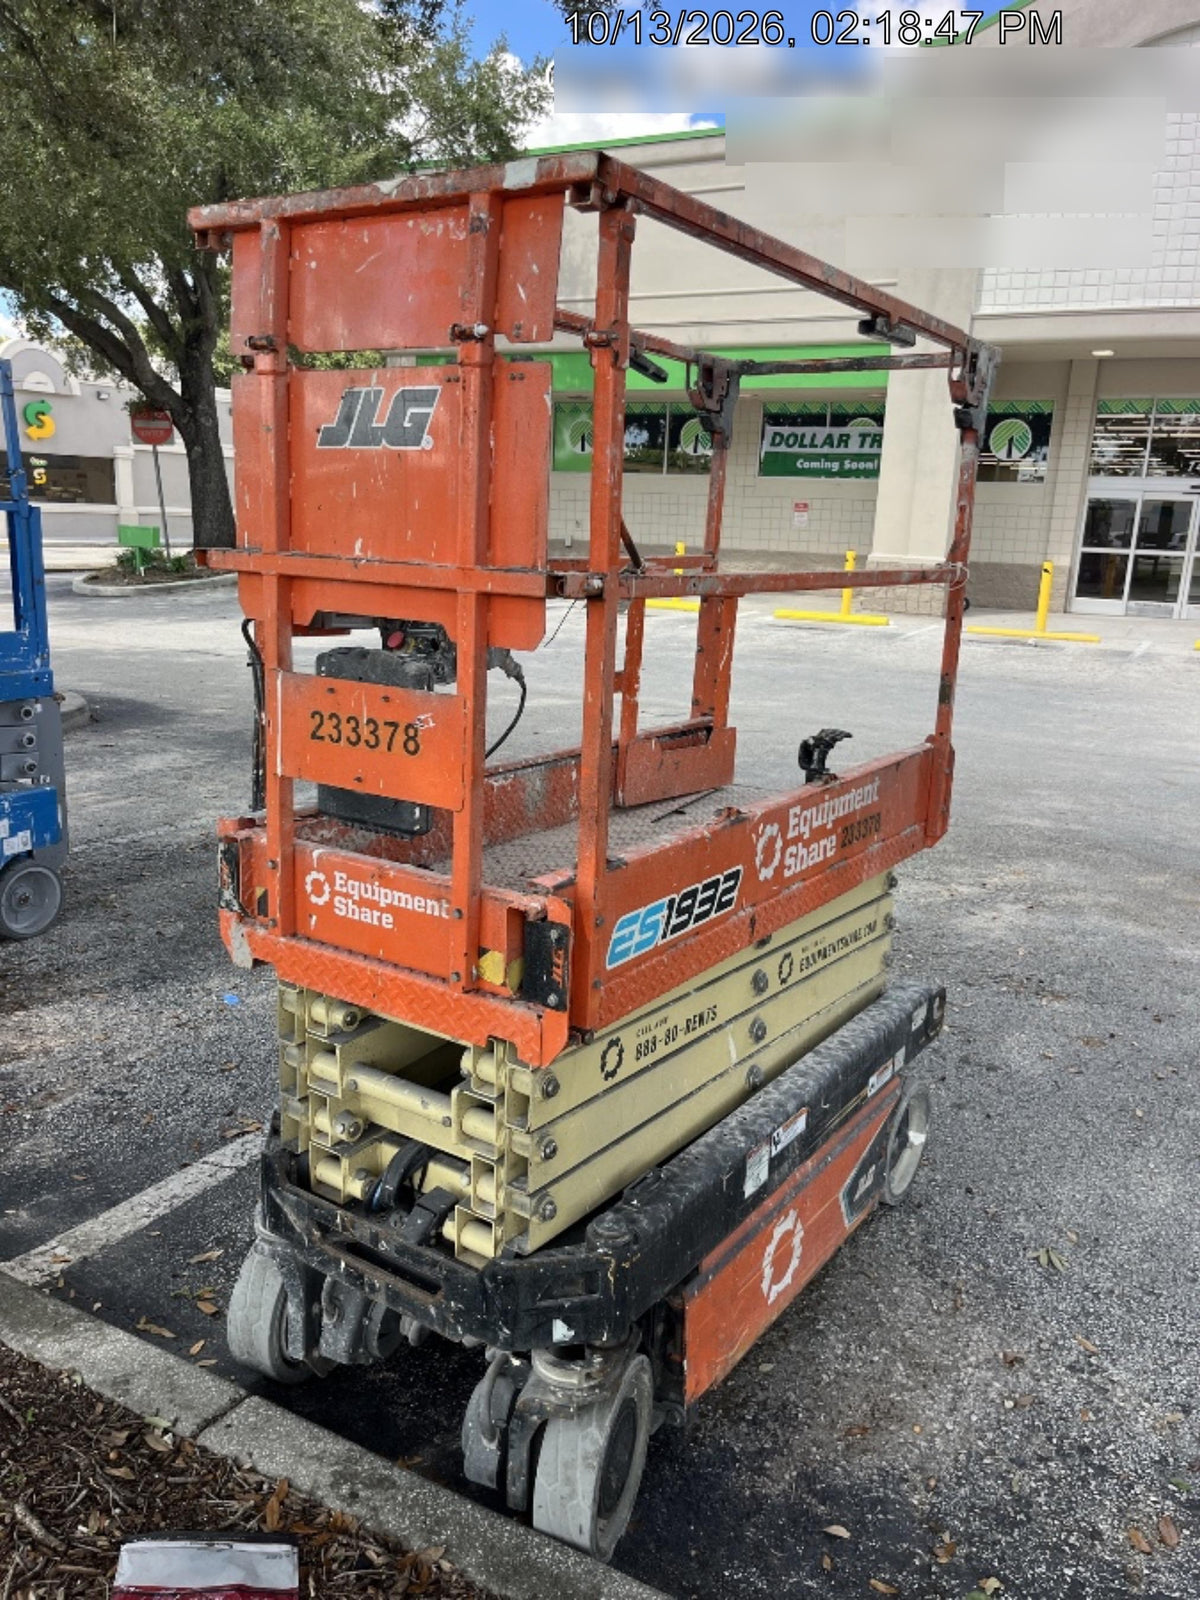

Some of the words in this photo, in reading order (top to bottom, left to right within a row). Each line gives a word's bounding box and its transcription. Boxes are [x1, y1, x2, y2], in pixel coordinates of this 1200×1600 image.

[316, 386, 442, 449] JLG
[769, 431, 851, 449] DOLLAR
[796, 458, 840, 472] Coming
[844, 458, 878, 470] Soon!
[309, 710, 421, 757] 233378
[787, 777, 880, 840] Equipment
[783, 834, 837, 878] Share
[333, 870, 450, 920] Equipment
[333, 896, 394, 929] Share
[606, 864, 744, 970] ES1932
